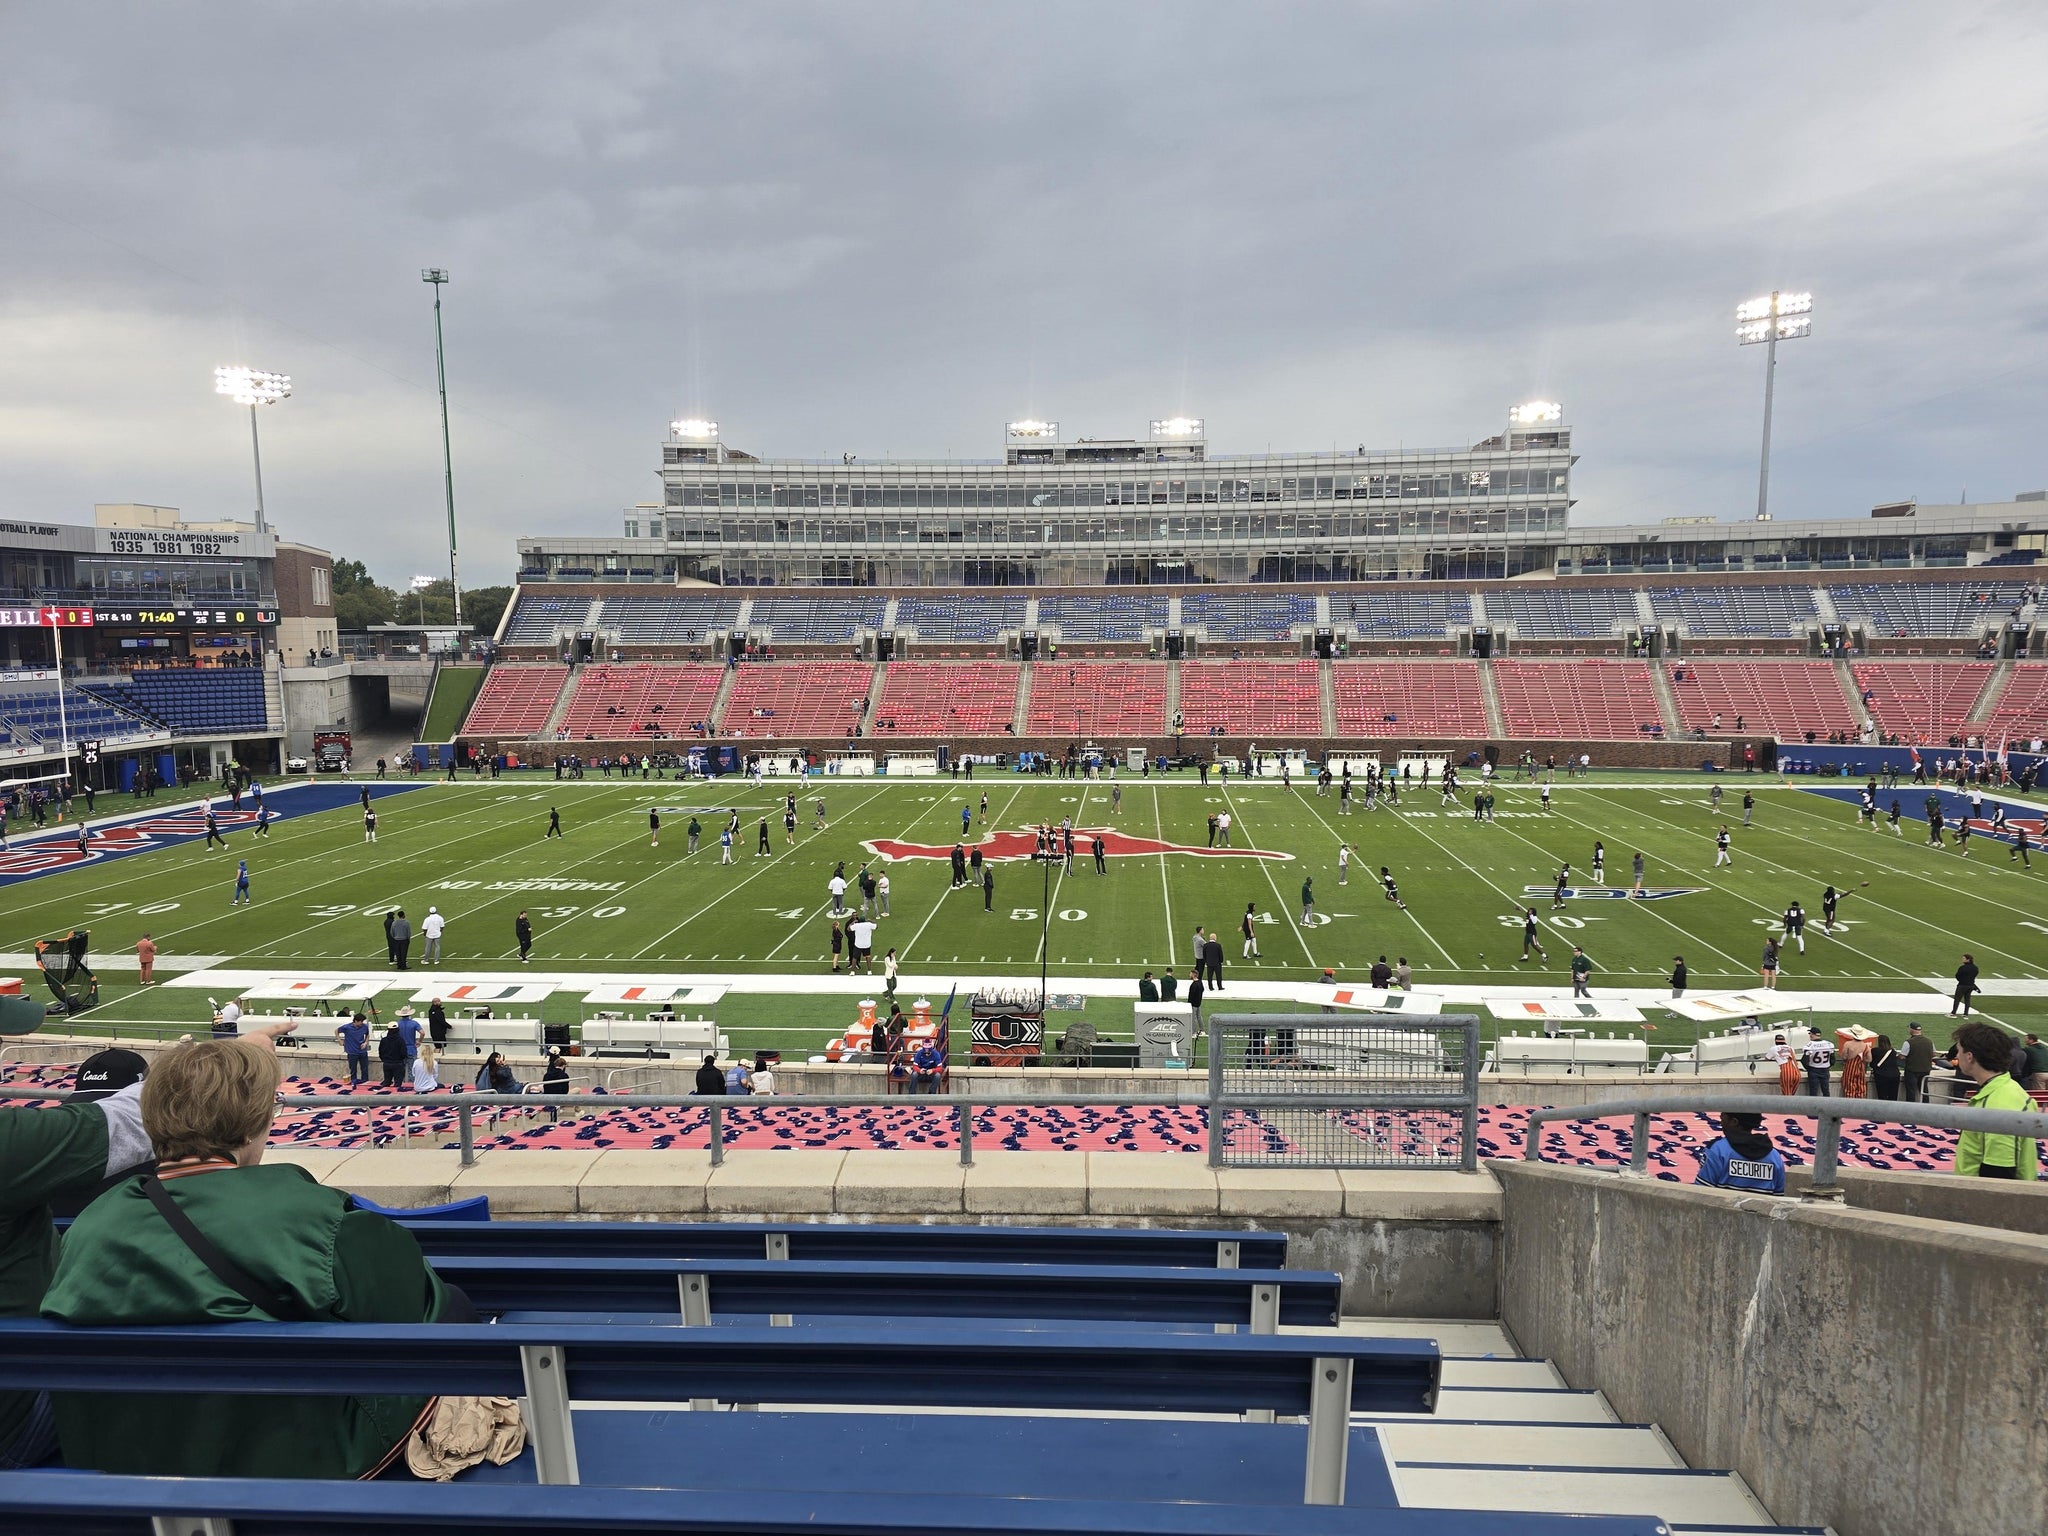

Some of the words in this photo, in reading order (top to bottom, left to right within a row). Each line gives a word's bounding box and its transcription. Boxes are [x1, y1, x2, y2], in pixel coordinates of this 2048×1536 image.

[29, 526, 59, 536] PLAYOFF
[110, 531, 160, 542] NATIONAL
[162, 533, 240, 544] CHAMPIONSHIPS
[110, 541, 144, 553] 1935
[152, 542, 183, 554] 1981
[190, 543, 222, 555] 1982
[68, 611, 76, 623] 0
[95, 613, 110, 621] 1ST
[110, 613, 119, 621] &
[120, 613, 132, 622] 10
[139, 612, 175, 623] 71:40
[195, 616, 207, 624] 25
[235, 611, 245, 623] 0
[85, 751, 98, 764] 25
[1009, 908, 1088, 921] 50
[990, 1021, 1020, 1040] U
[1150, 1023, 1179, 1032] ACC
[1812, 1050, 1831, 1064] 63
[83, 1070, 109, 1081] Coach
[1730, 1160, 1774, 1180] SECURITY
